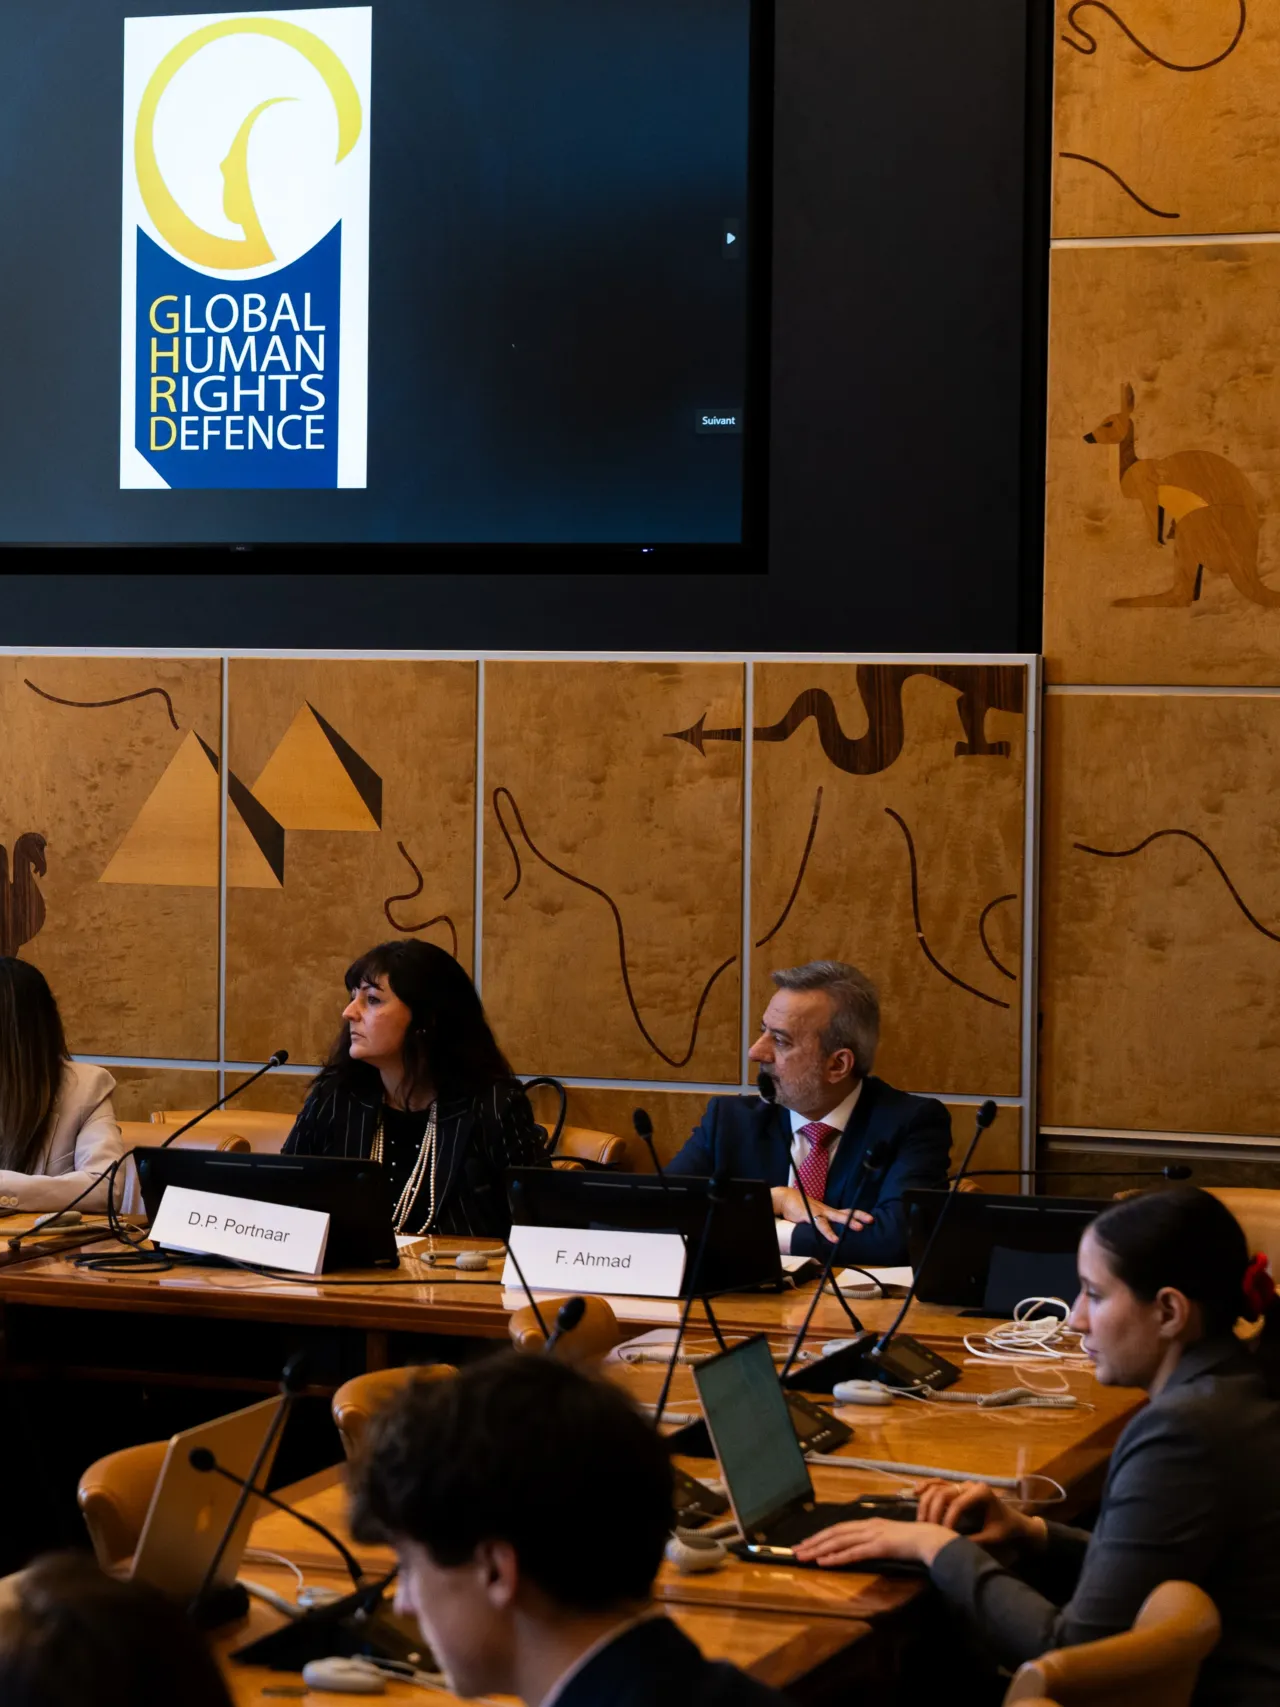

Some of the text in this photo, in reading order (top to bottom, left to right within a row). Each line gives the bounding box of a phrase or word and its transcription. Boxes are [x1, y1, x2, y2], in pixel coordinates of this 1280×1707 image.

[149, 293, 326, 334] GLOBAL
[150, 334, 325, 374] HUMAN
[150, 373, 326, 413] RIGHTS
[149, 414, 325, 451] DEFENCE
[702, 415, 736, 425] Suivant
[188, 1211, 290, 1243] D.P. Portnaar
[555, 1250, 632, 1269] F. Ahmad
